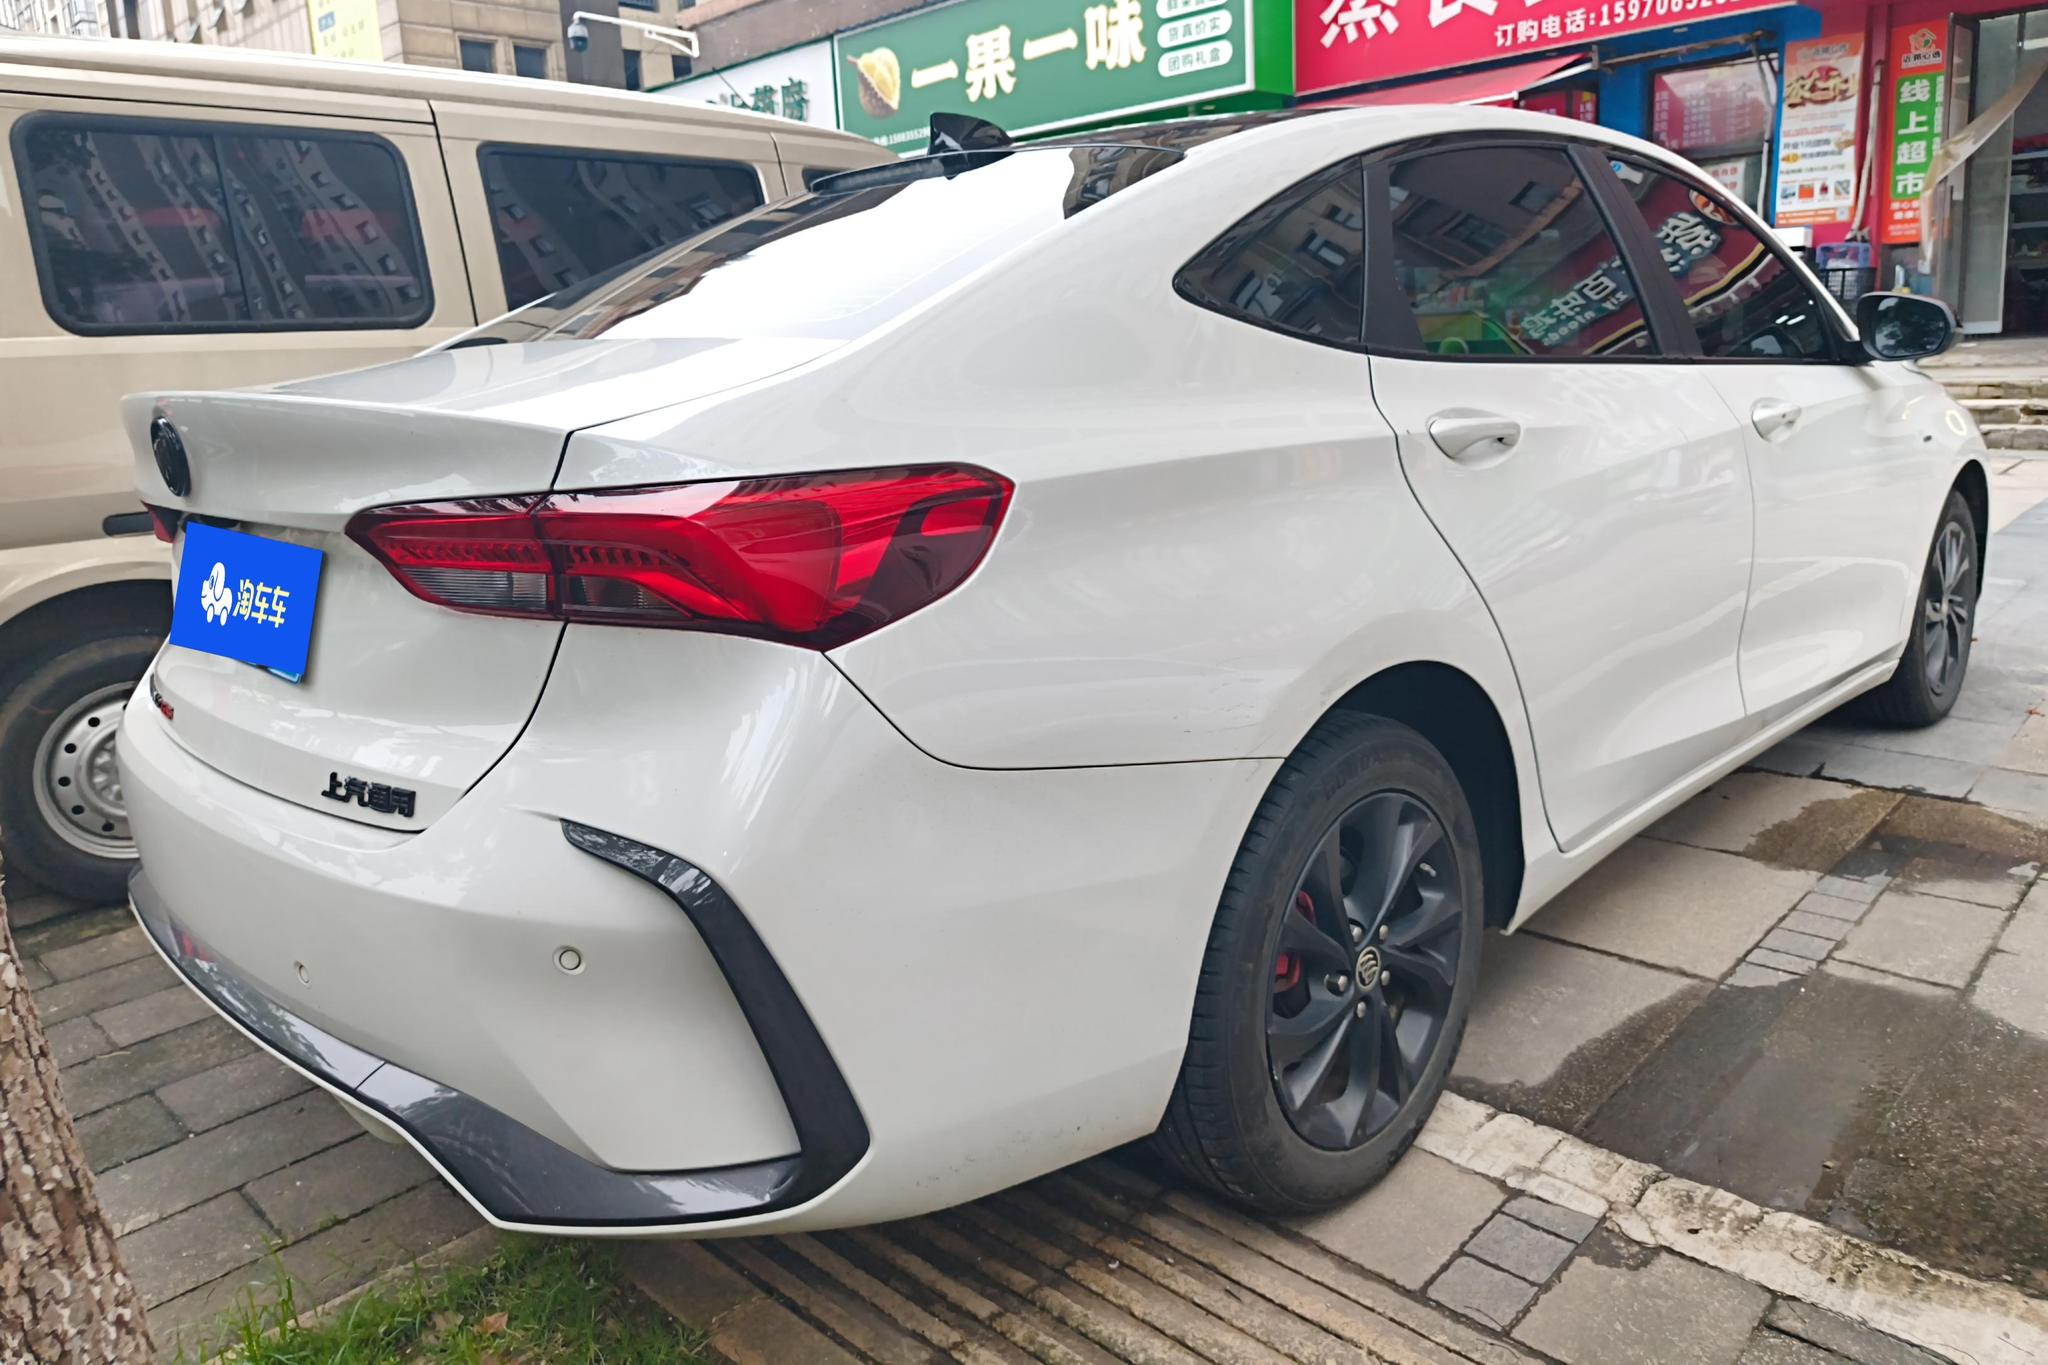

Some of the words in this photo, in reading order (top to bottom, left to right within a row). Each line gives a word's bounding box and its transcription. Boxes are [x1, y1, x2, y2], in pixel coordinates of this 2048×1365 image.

[911, 0, 1147, 103] 一果一味
[1168, 17, 1221, 42] 货真价实
[1168, 47, 1221, 72] 团购礼盒
[1896, 78, 1930, 195] 线上超市
